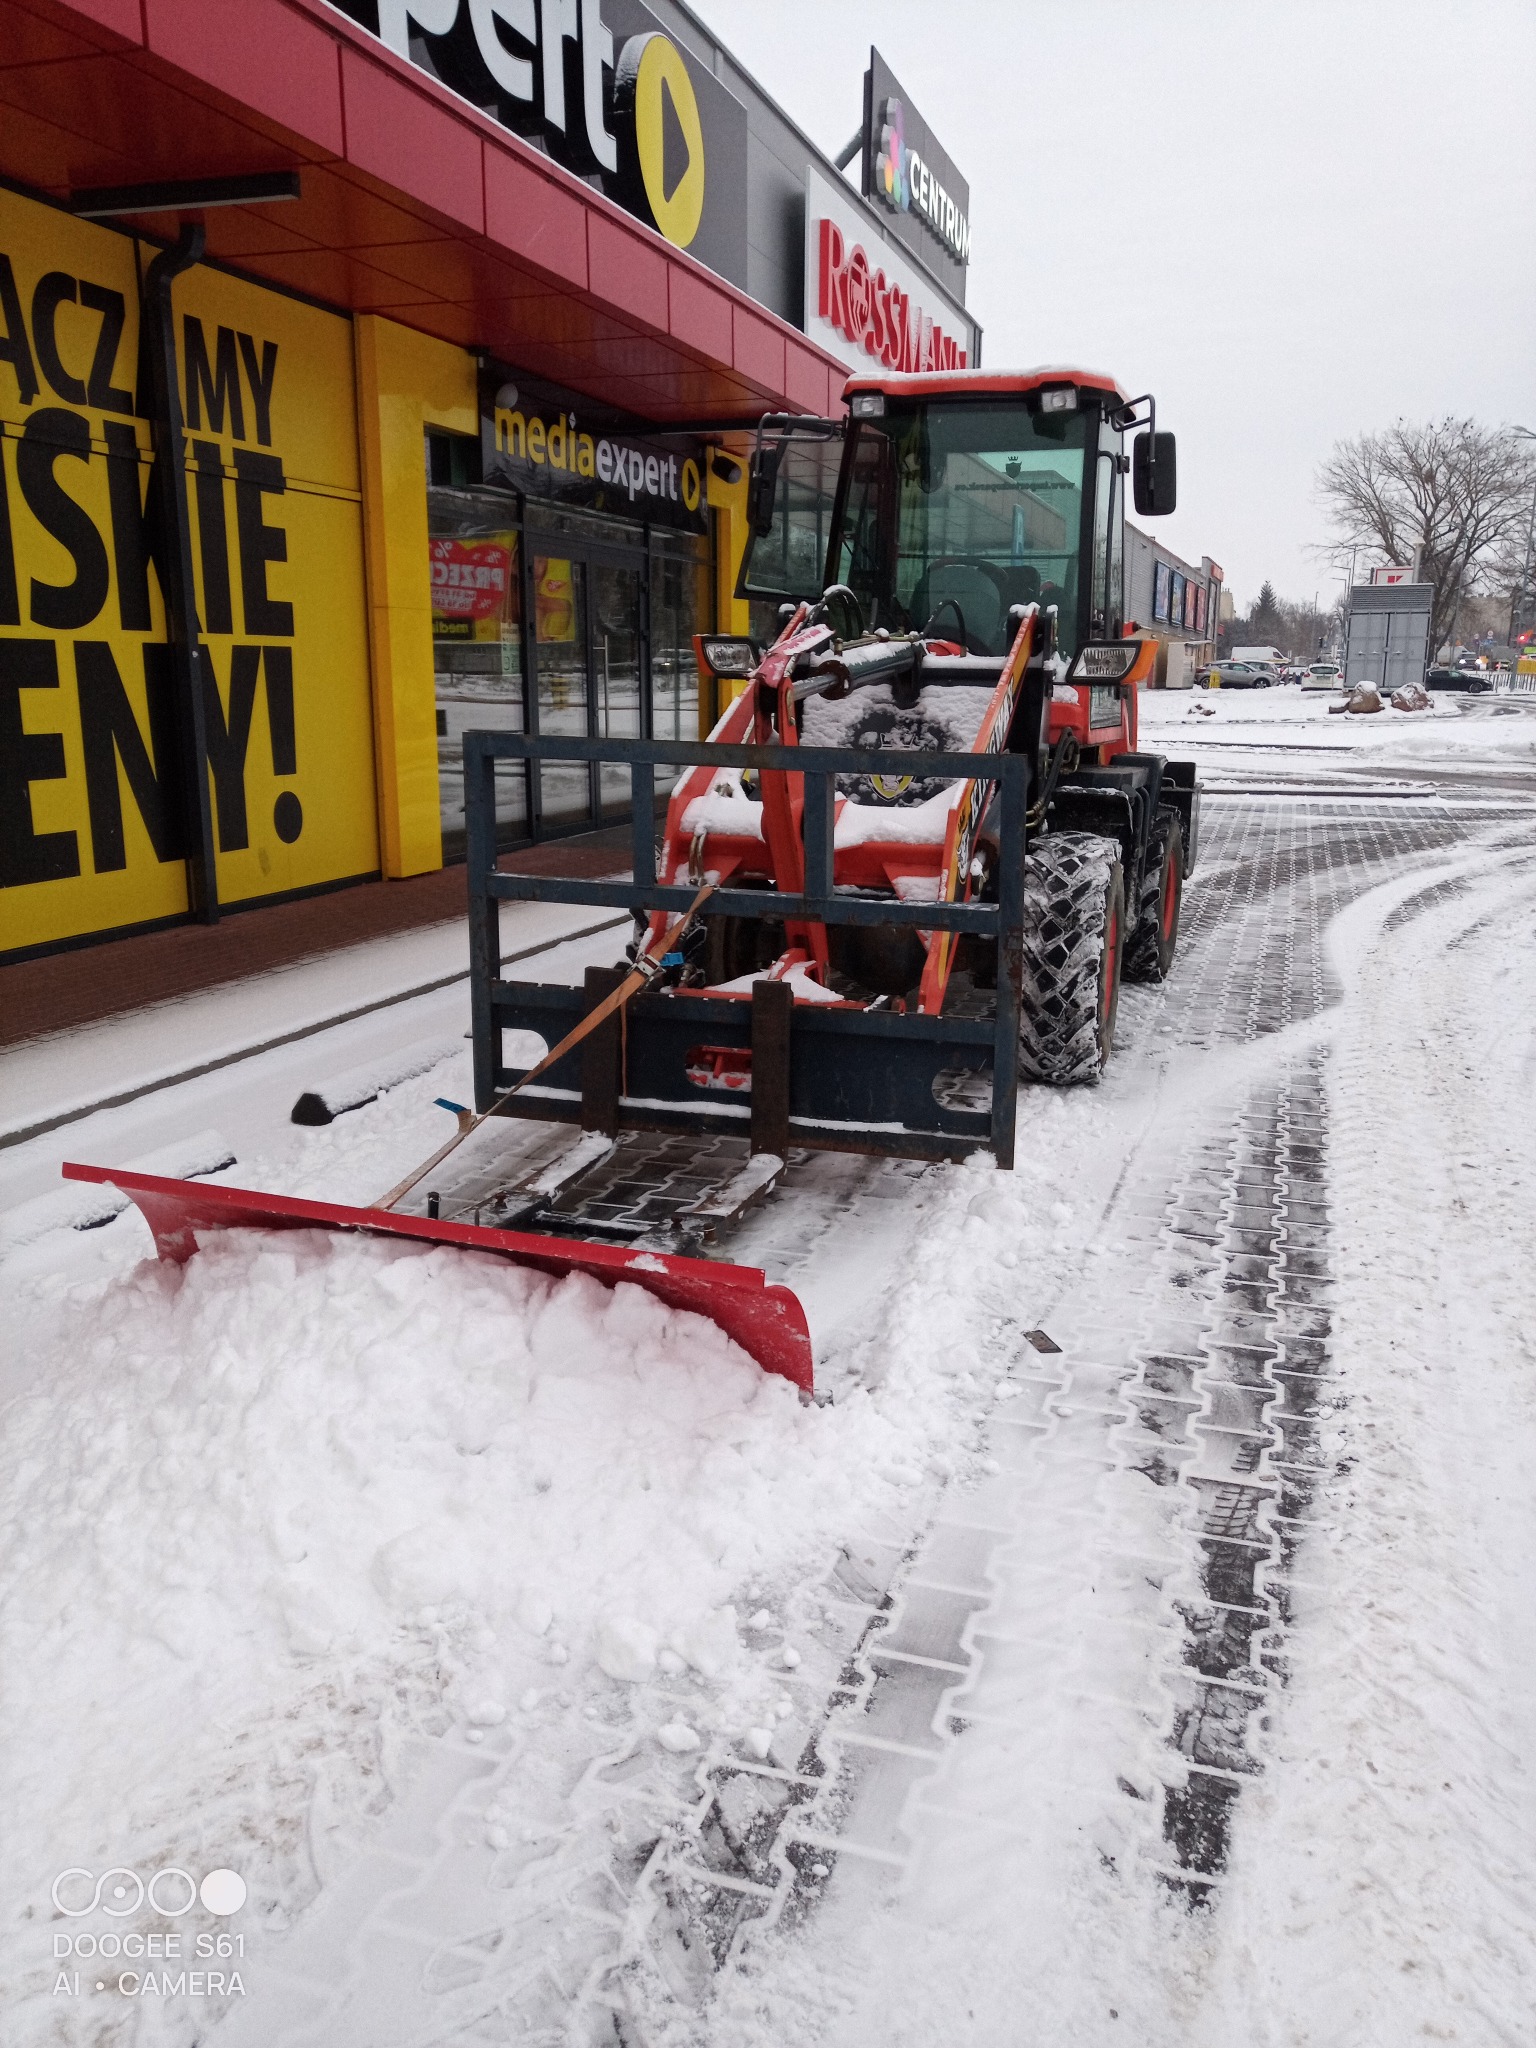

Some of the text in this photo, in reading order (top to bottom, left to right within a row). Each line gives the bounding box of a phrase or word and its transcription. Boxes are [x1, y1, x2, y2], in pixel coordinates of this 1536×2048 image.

[909, 151, 972, 263] CENTRUM
[0, 254, 279, 447] ĄCZMY
[493, 406, 679, 502] mediaexpert
